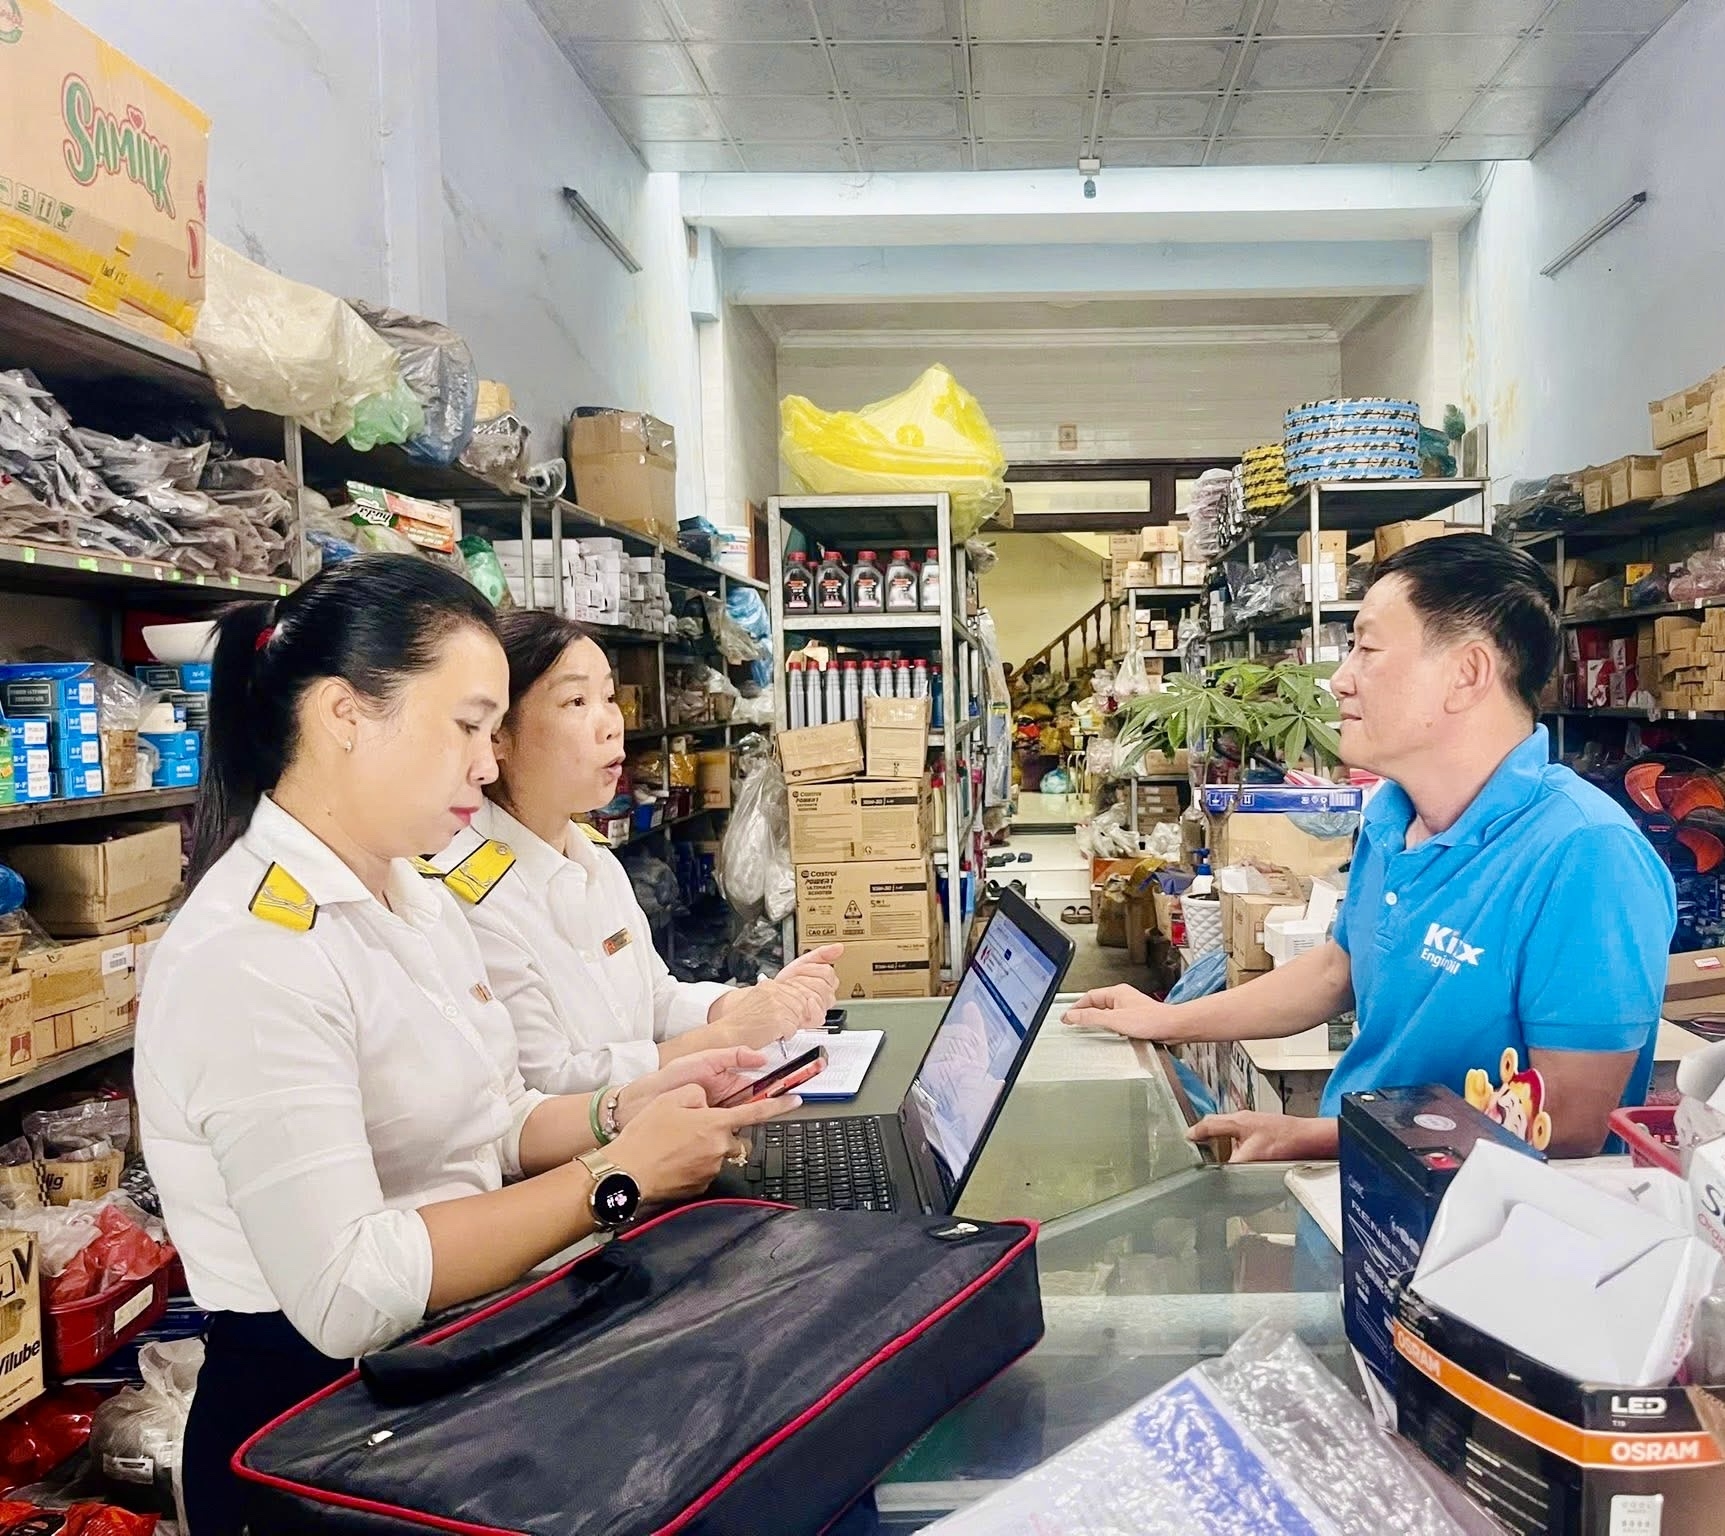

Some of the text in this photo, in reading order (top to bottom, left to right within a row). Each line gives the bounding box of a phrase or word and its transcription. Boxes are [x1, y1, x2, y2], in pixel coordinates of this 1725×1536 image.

[810, 871, 837, 879] Castrol
[1611, 1396, 1667, 1414] LED
[1611, 1441, 1699, 1461] OSRAM
